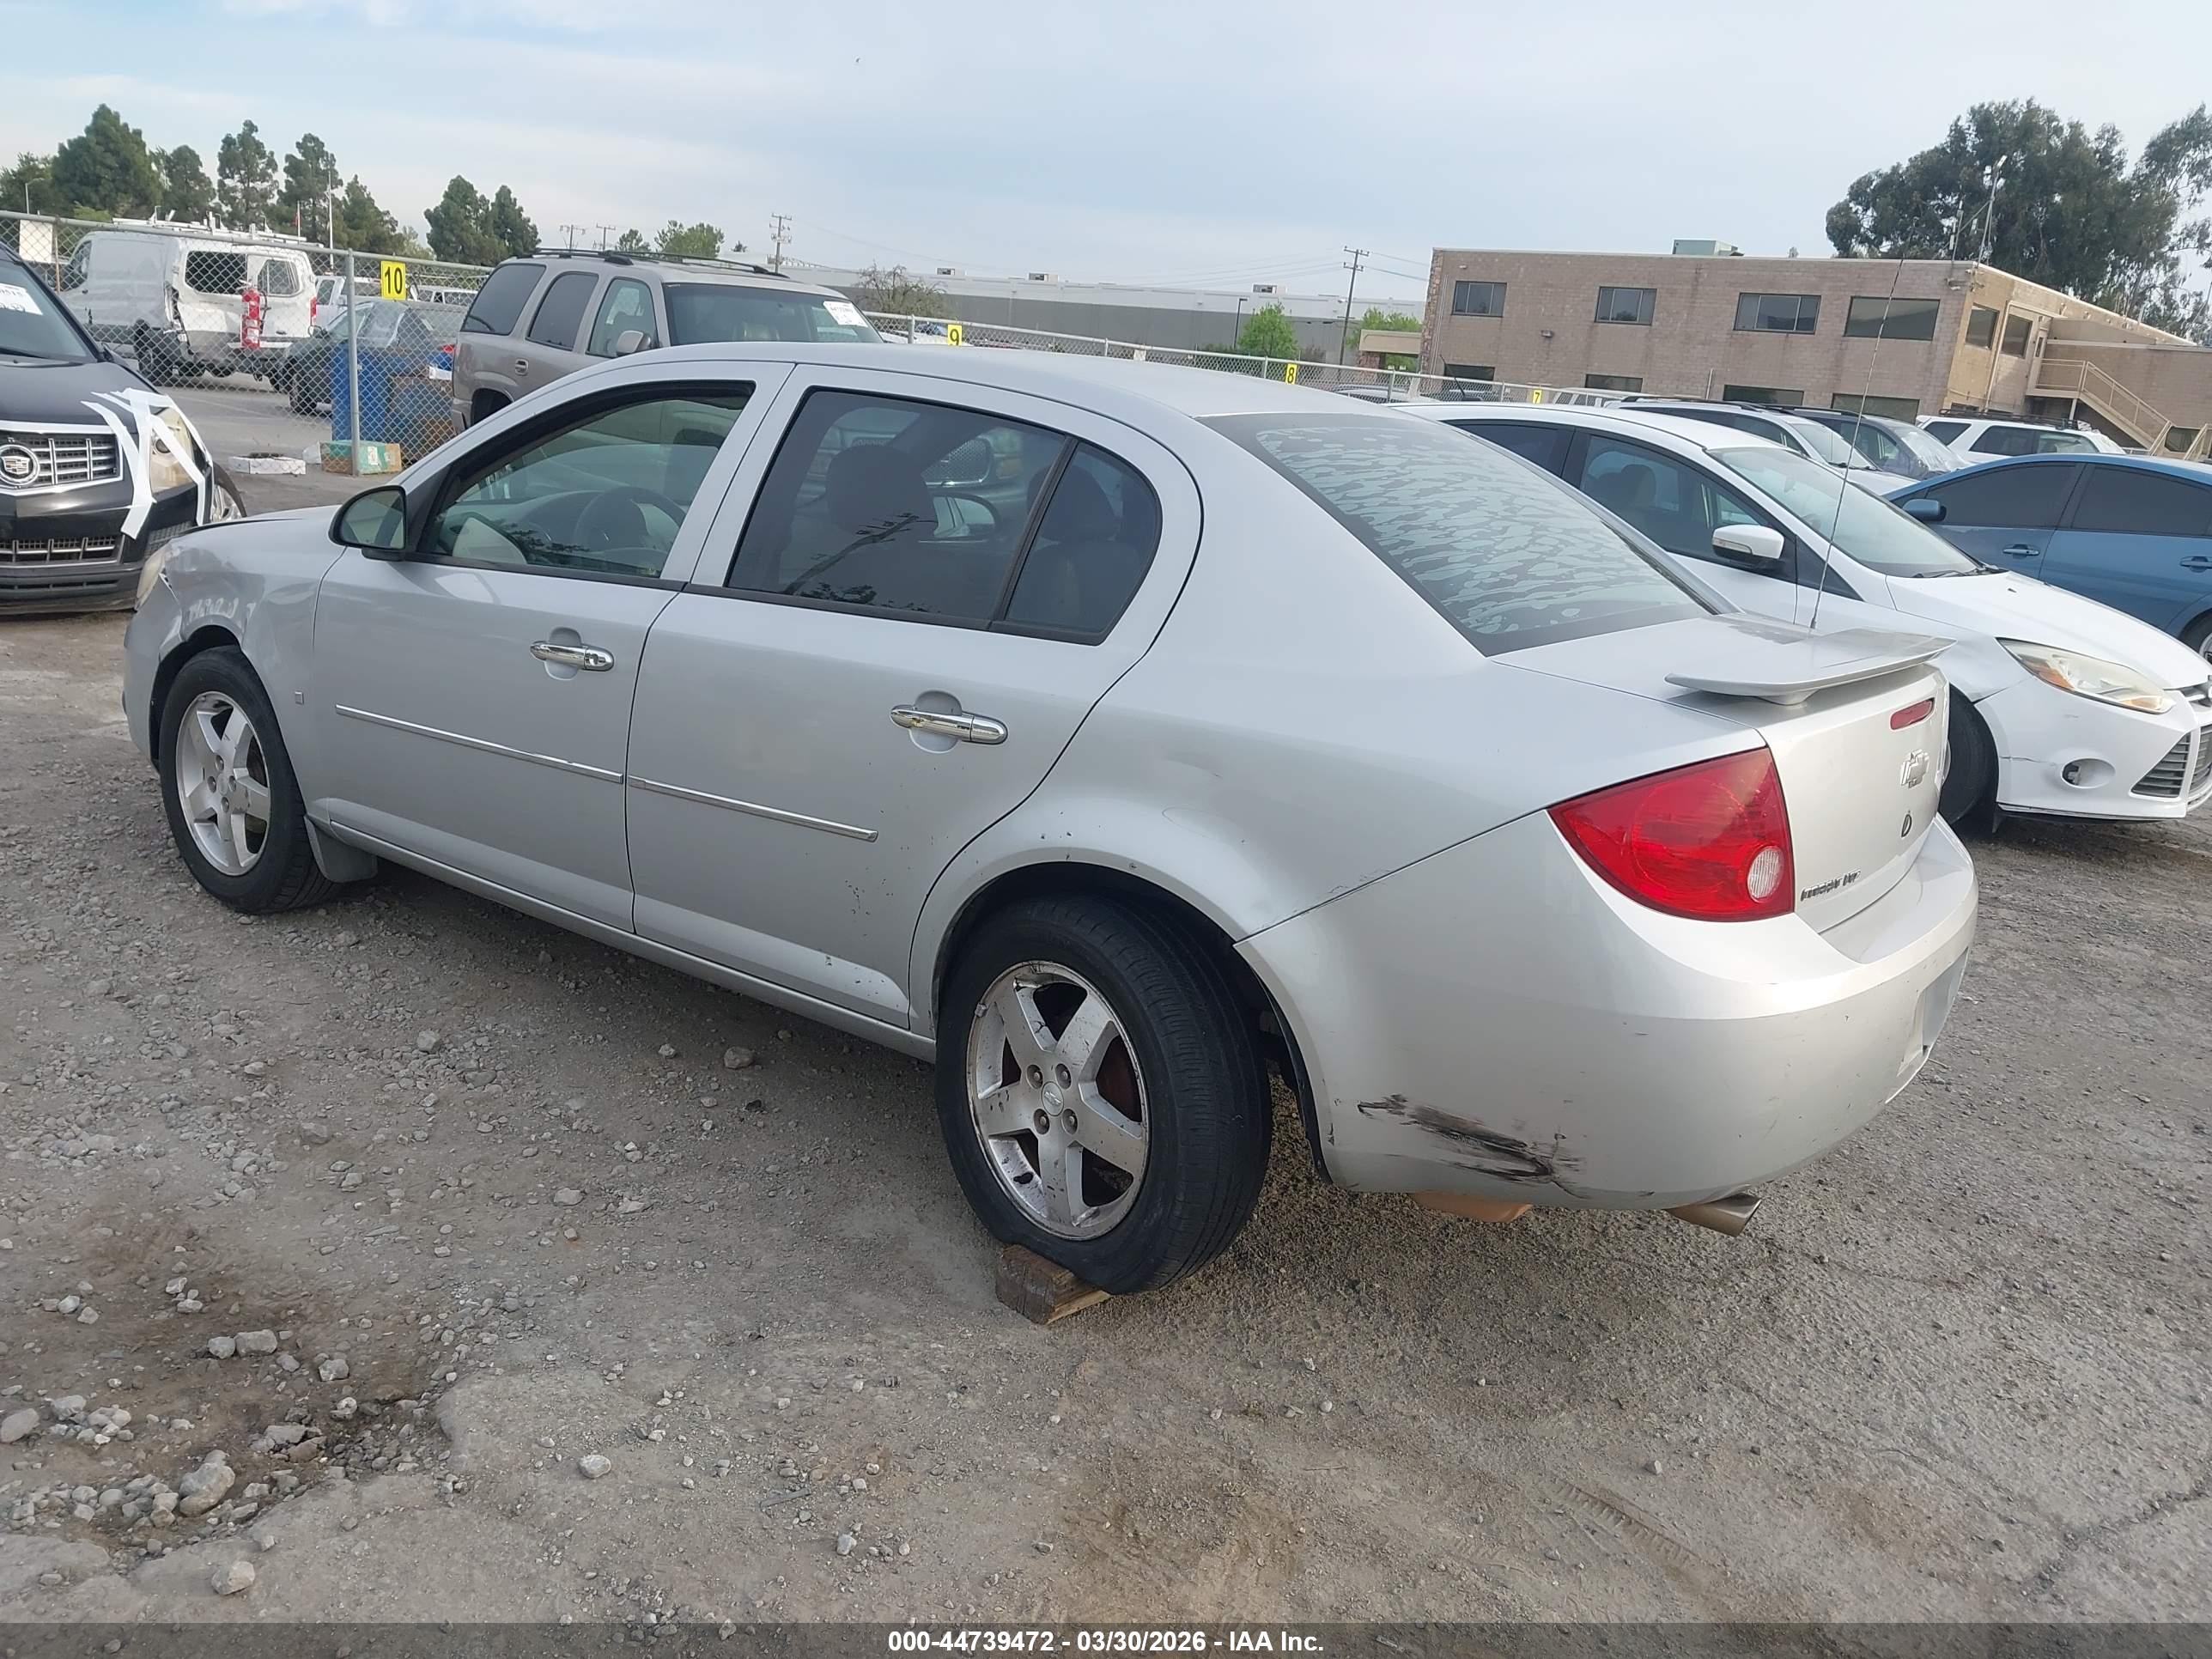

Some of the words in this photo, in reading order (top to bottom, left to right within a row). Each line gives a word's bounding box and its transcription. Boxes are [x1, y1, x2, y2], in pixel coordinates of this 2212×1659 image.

[384, 265, 403, 295] 10
[950, 328, 960, 346] 9
[1287, 367, 1295, 384] 8
[1534, 392, 1540, 404] 7
